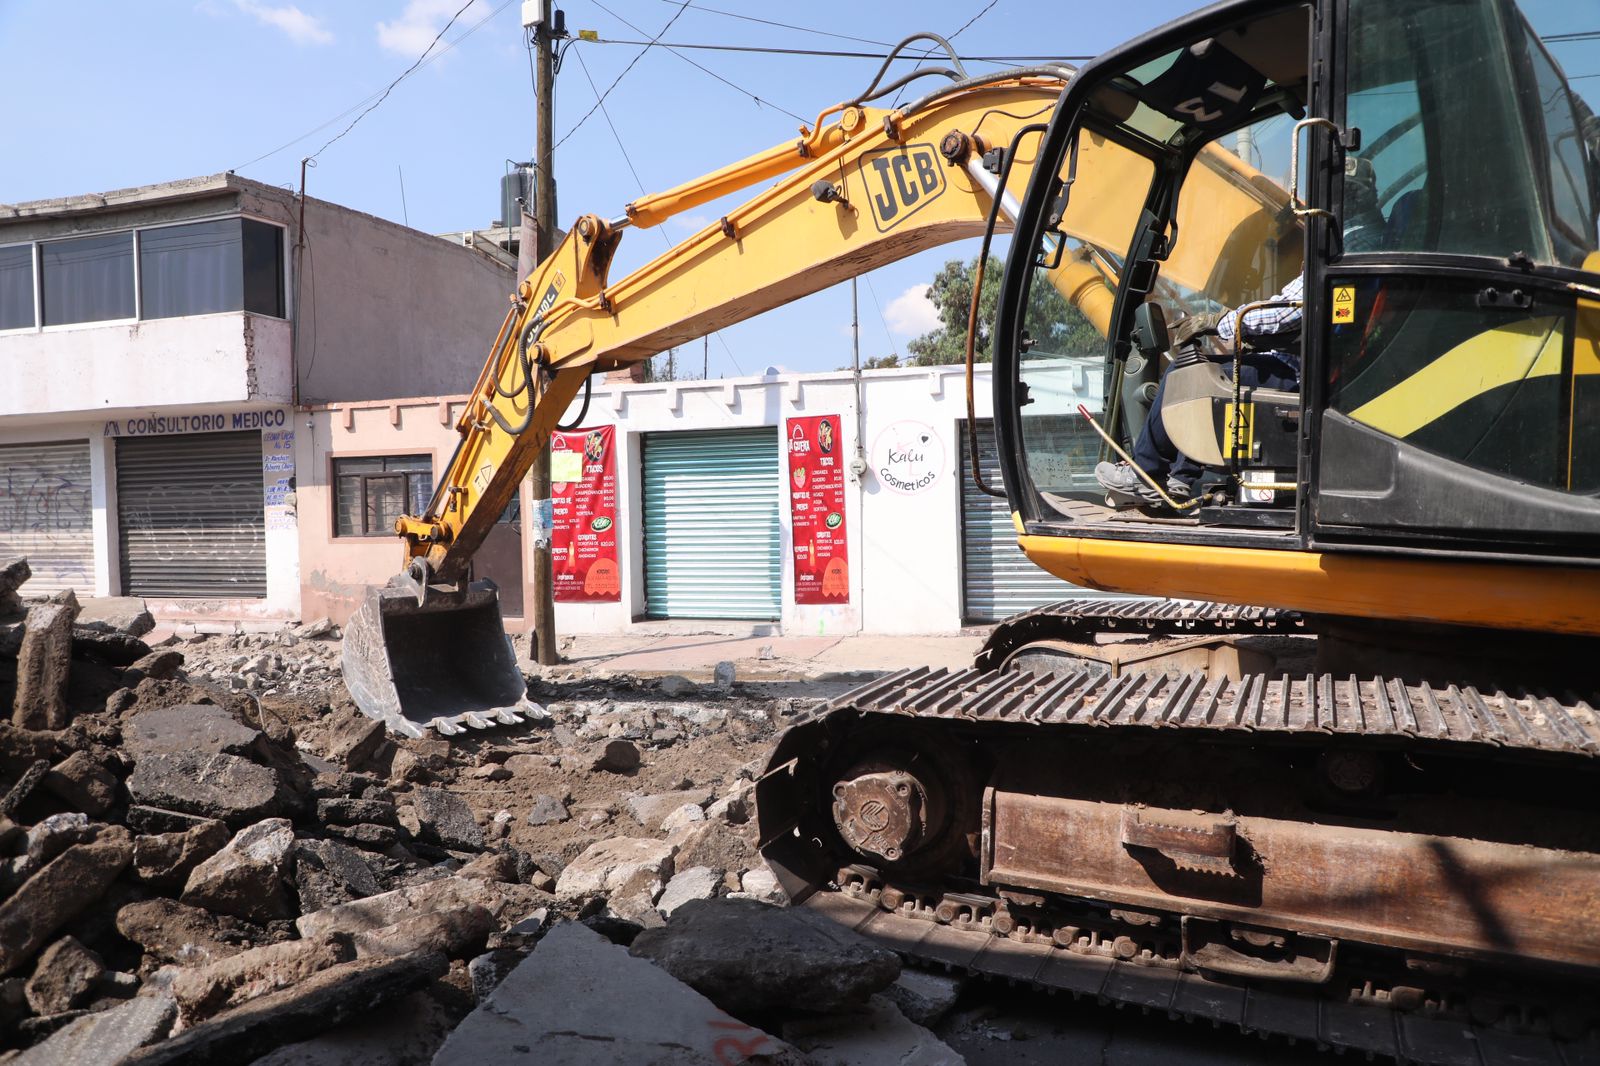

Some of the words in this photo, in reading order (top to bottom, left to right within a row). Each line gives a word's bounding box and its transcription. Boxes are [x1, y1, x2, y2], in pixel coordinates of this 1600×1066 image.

[872, 152, 938, 221] JCB
[127, 413, 225, 435] CONSULTORIO
[232, 409, 285, 429] MEDICO
[586, 465, 603, 473] TACOS
[880, 468, 935, 491] Cosmeticos
